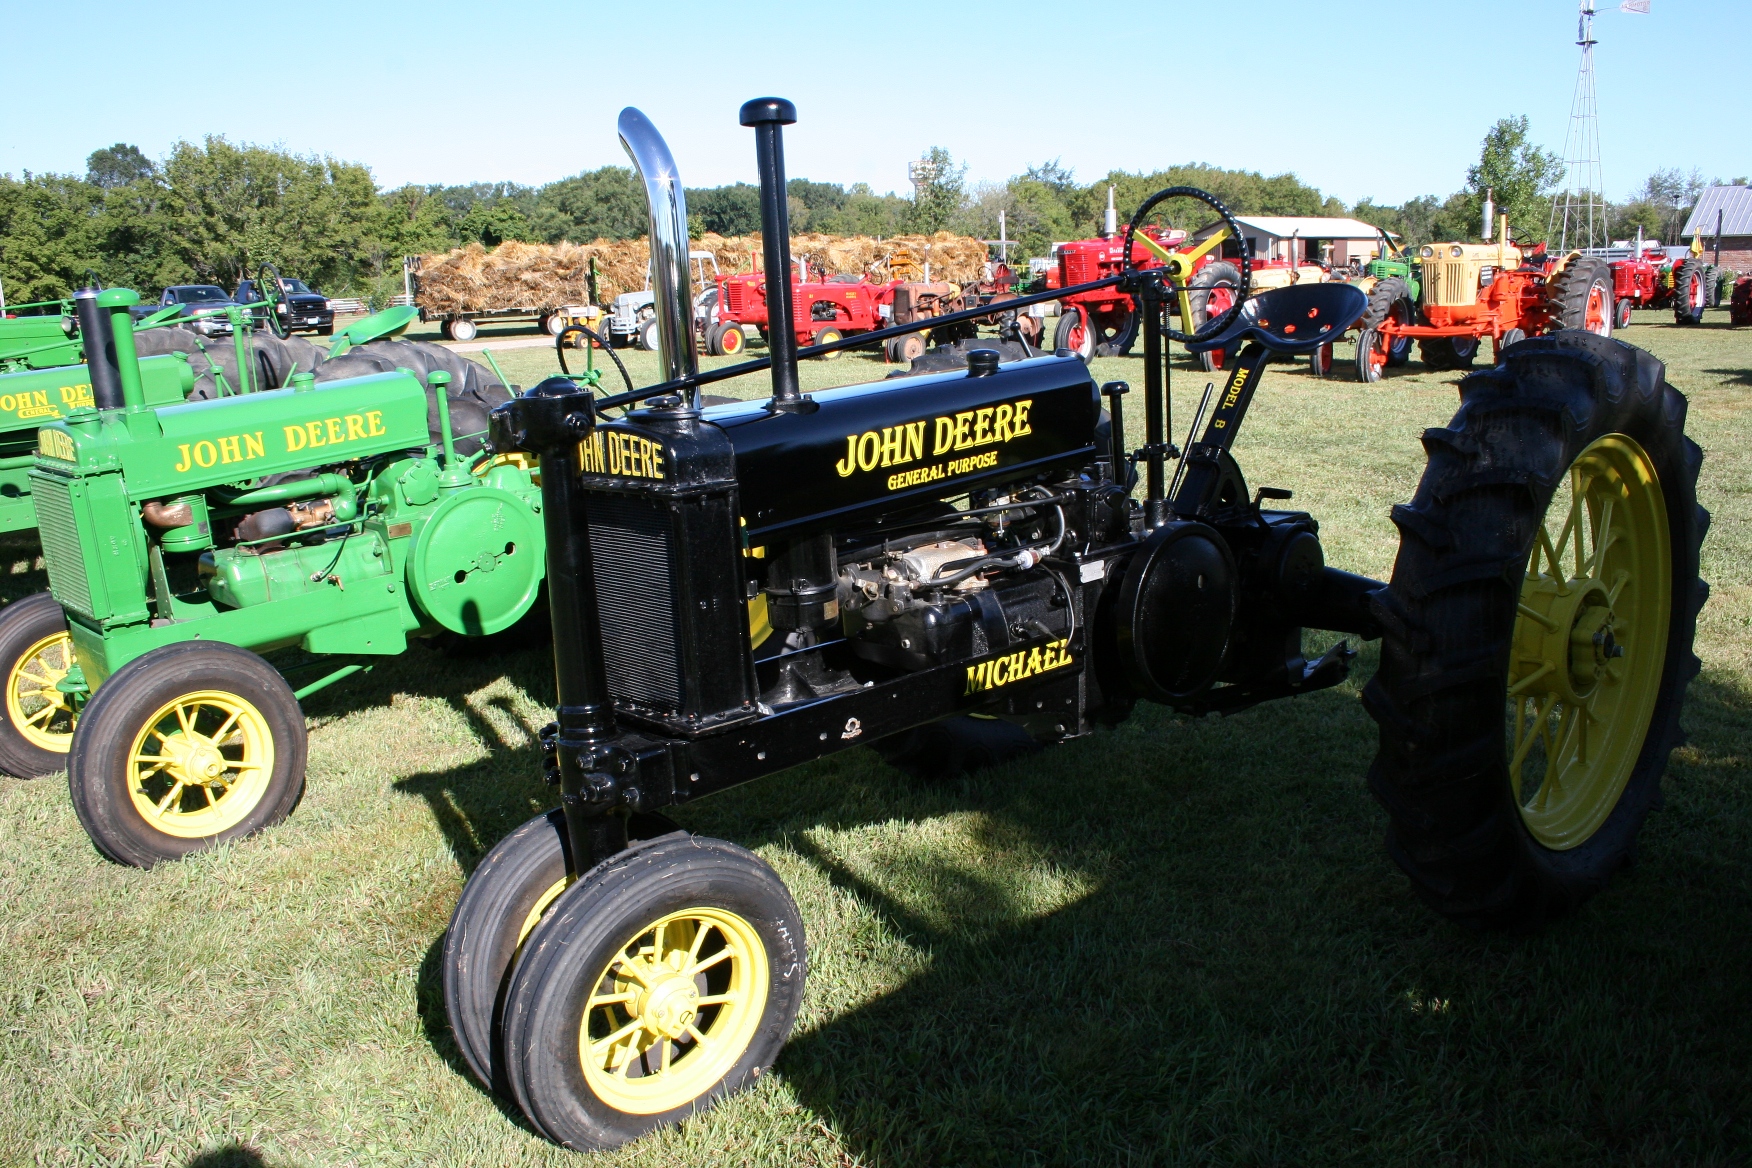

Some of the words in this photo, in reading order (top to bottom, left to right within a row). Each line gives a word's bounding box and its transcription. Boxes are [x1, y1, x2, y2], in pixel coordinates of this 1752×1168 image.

[0, 389, 48, 411] OHN
[1221, 367, 1250, 410] MODEL
[175, 431, 266, 473] JOHN
[283, 410, 387, 453] DEERE
[836, 420, 926, 478] JOHN
[932, 399, 1033, 456] DEERE
[1214, 419, 1226, 428] B
[607, 431, 666, 479] DEERE
[887, 462, 946, 491] GENERAL
[947, 450, 998, 477] PURPOSE
[963, 638, 1073, 697] MICHAEL
